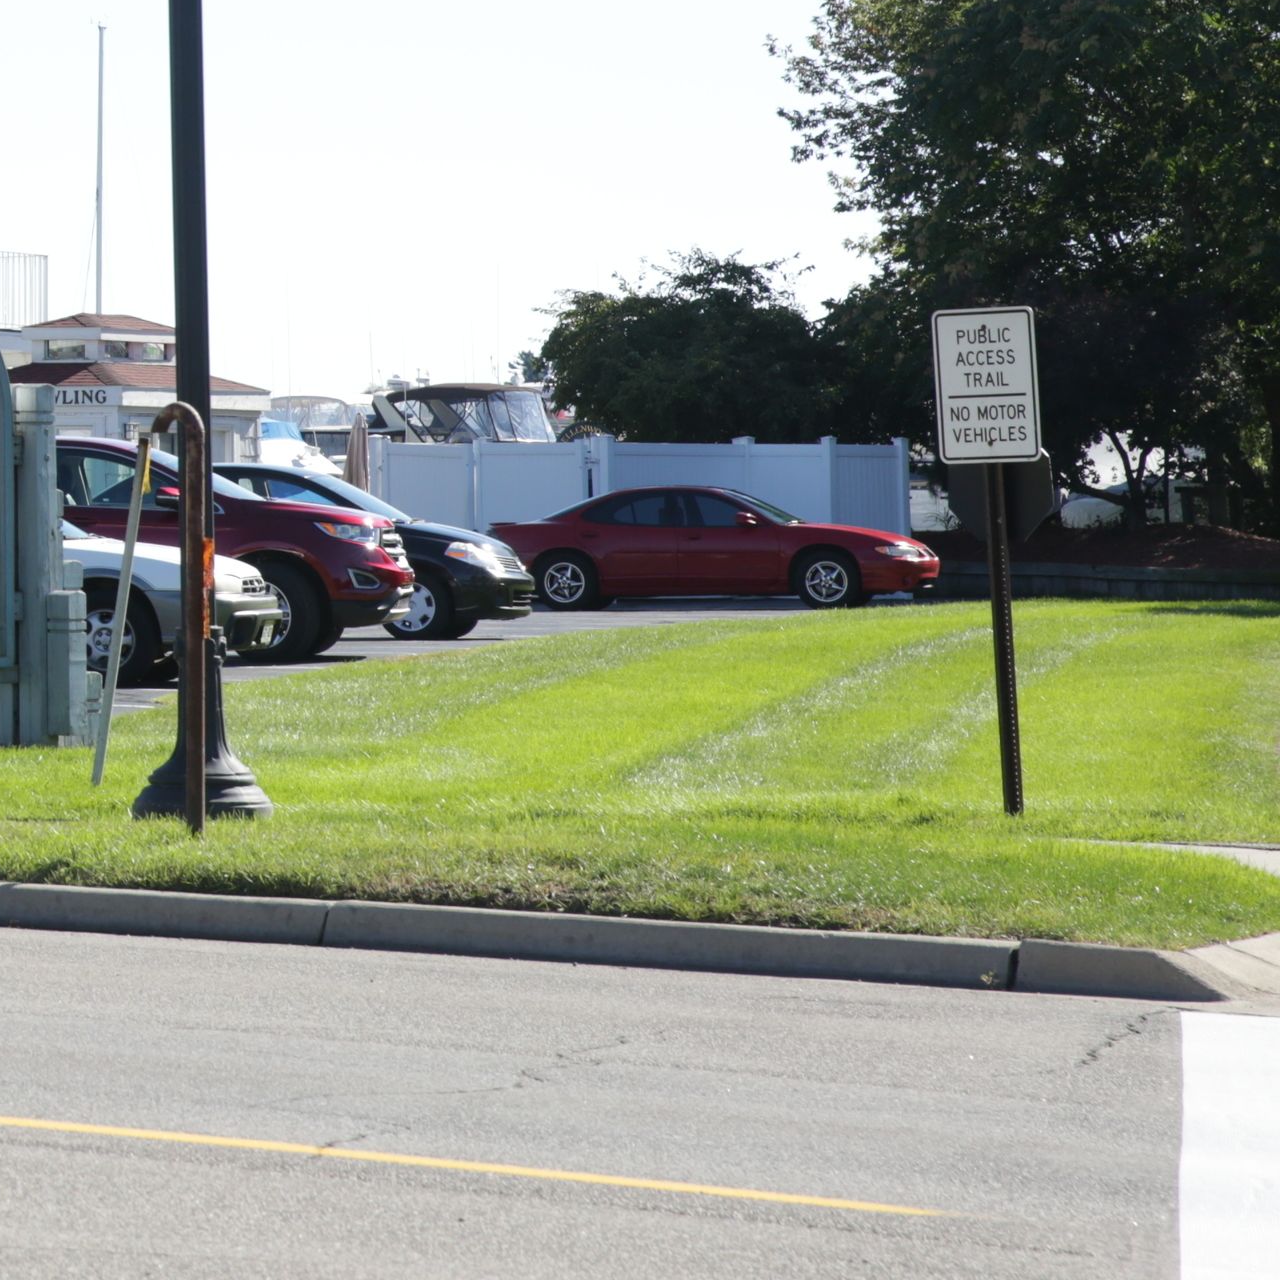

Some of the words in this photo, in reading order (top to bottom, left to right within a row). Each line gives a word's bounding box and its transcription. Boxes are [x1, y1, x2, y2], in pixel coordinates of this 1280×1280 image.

[956, 327, 1011, 345] PUBLIC
[955, 349, 1016, 367] ACCESS
[964, 371, 1009, 388] TRAIL
[950, 406, 971, 422] NO
[977, 404, 1027, 421] MOTOR
[952, 426, 1028, 443] VEHICLES
